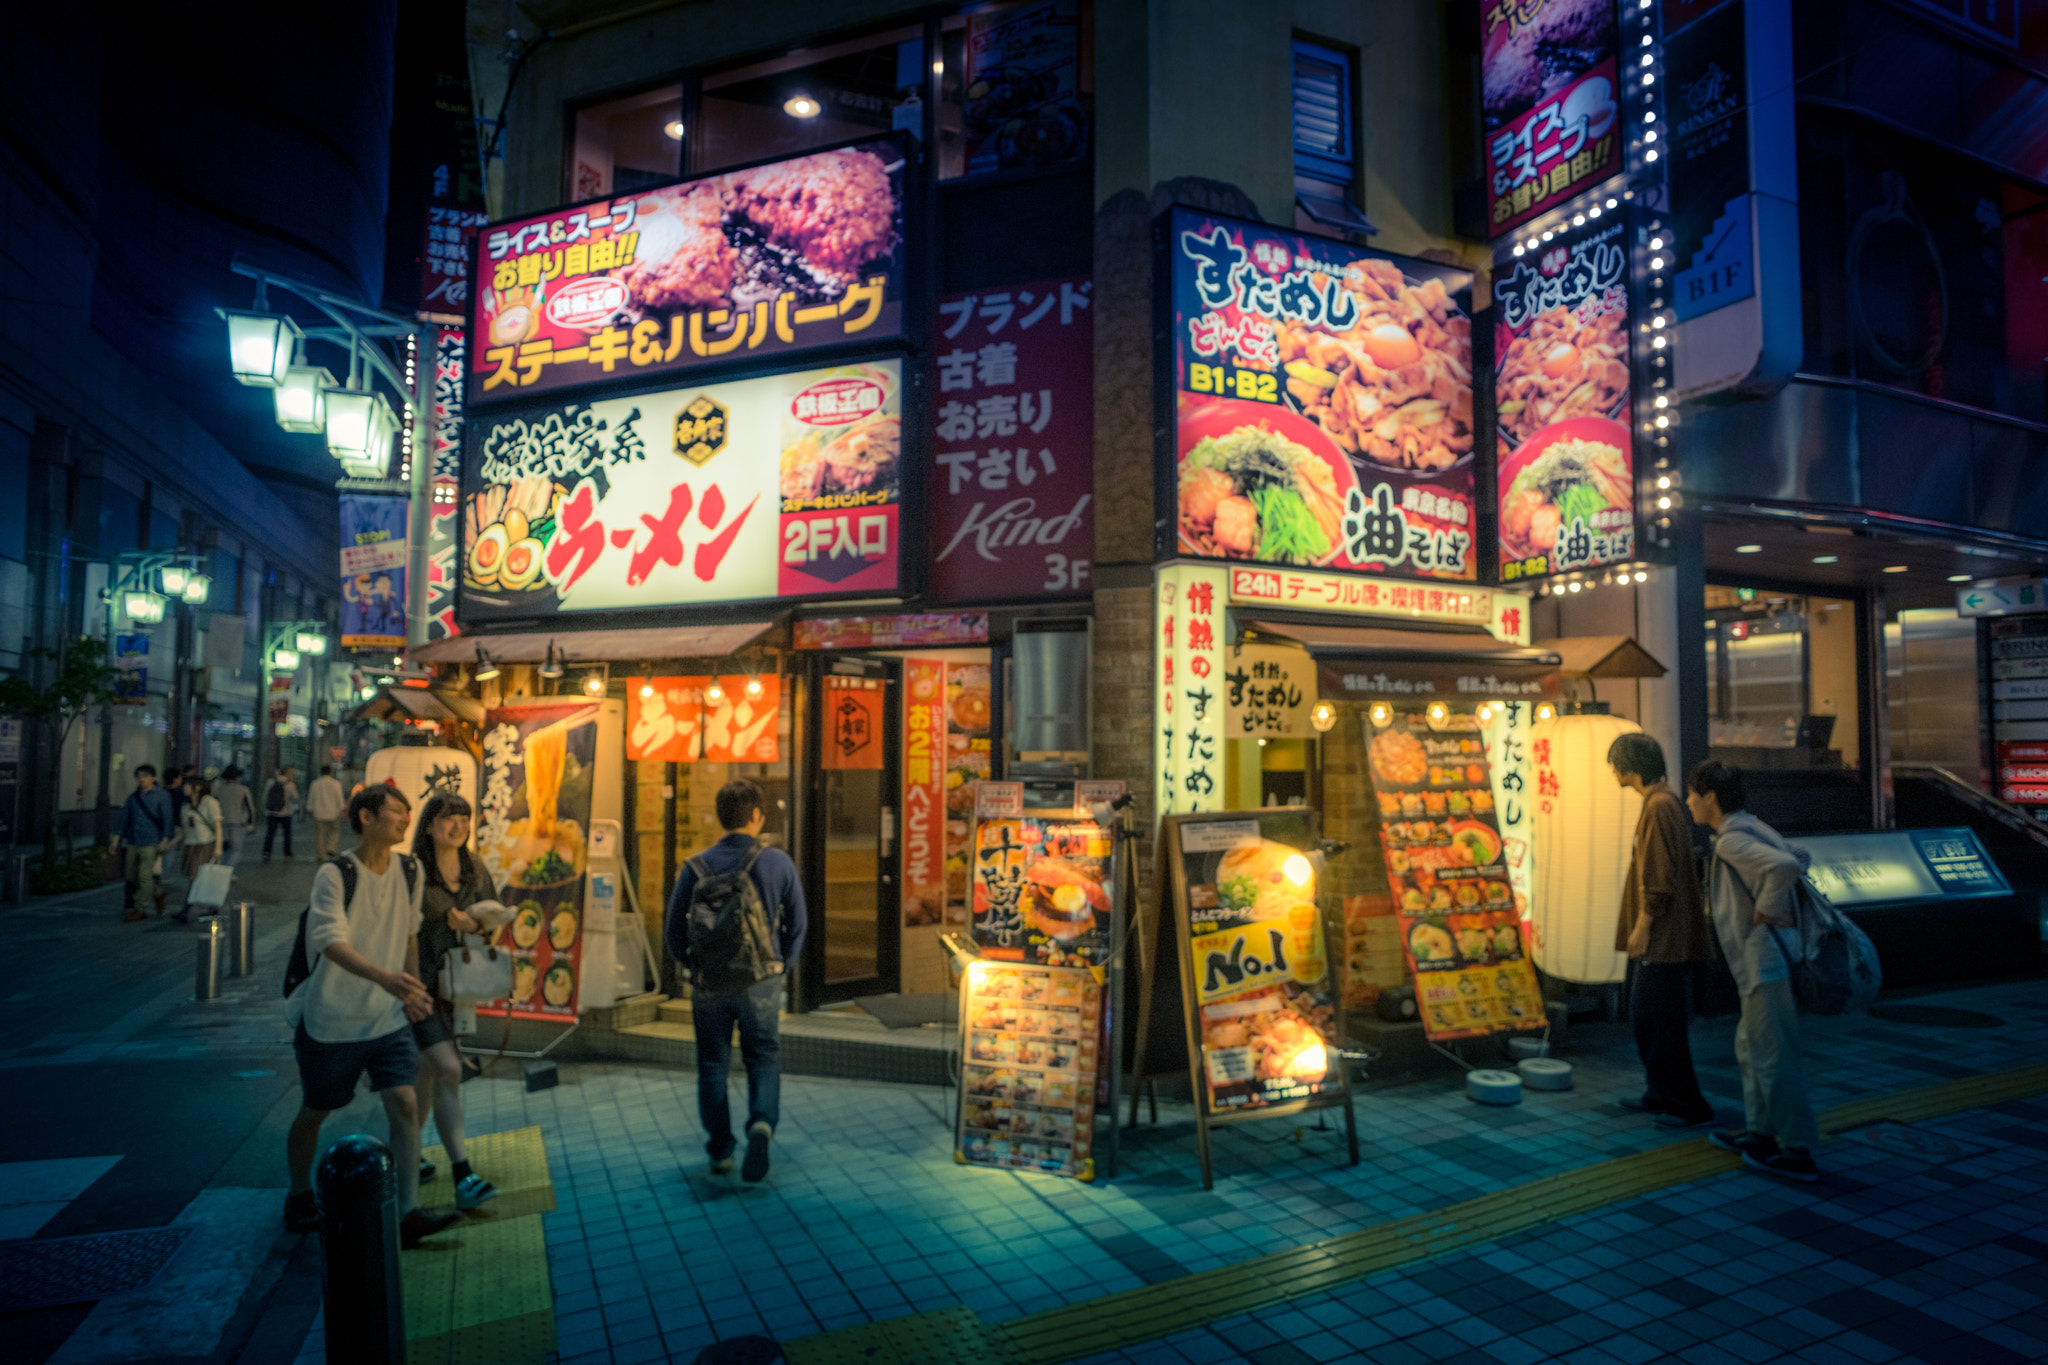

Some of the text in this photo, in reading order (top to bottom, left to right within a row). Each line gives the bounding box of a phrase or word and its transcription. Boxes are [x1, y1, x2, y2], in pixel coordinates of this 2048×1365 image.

[1492, 101, 1565, 167] ライス
[487, 200, 637, 258] ライス&スープ
[492, 232, 640, 290] お替り自由!!
[1181, 226, 1360, 332] すためし
[1495, 242, 1626, 329] すためし
[1688, 262, 1742, 302] B1F
[483, 276, 886, 391] ステーキ&ハンバーグ
[939, 280, 1092, 340] ブランド
[936, 342, 1018, 392] 古着
[936, 390, 1051, 442] お売り
[936, 448, 1057, 494] 下さい
[782, 490, 889, 513] ステーキ&ハンバーグ
[936, 494, 1092, 562] Kind
[1341, 482, 1472, 574] 油そば
[545, 479, 762, 595] ラーメン
[784, 515, 888, 563] 2F入口
[1553, 516, 1635, 572] 油そば
[1043, 553, 1089, 591] 3F
[1237, 573, 1279, 597] 24h
[1225, 665, 1302, 708] すためし
[631, 690, 778, 758] ラーメン
[1203, 928, 1287, 992] No.1
